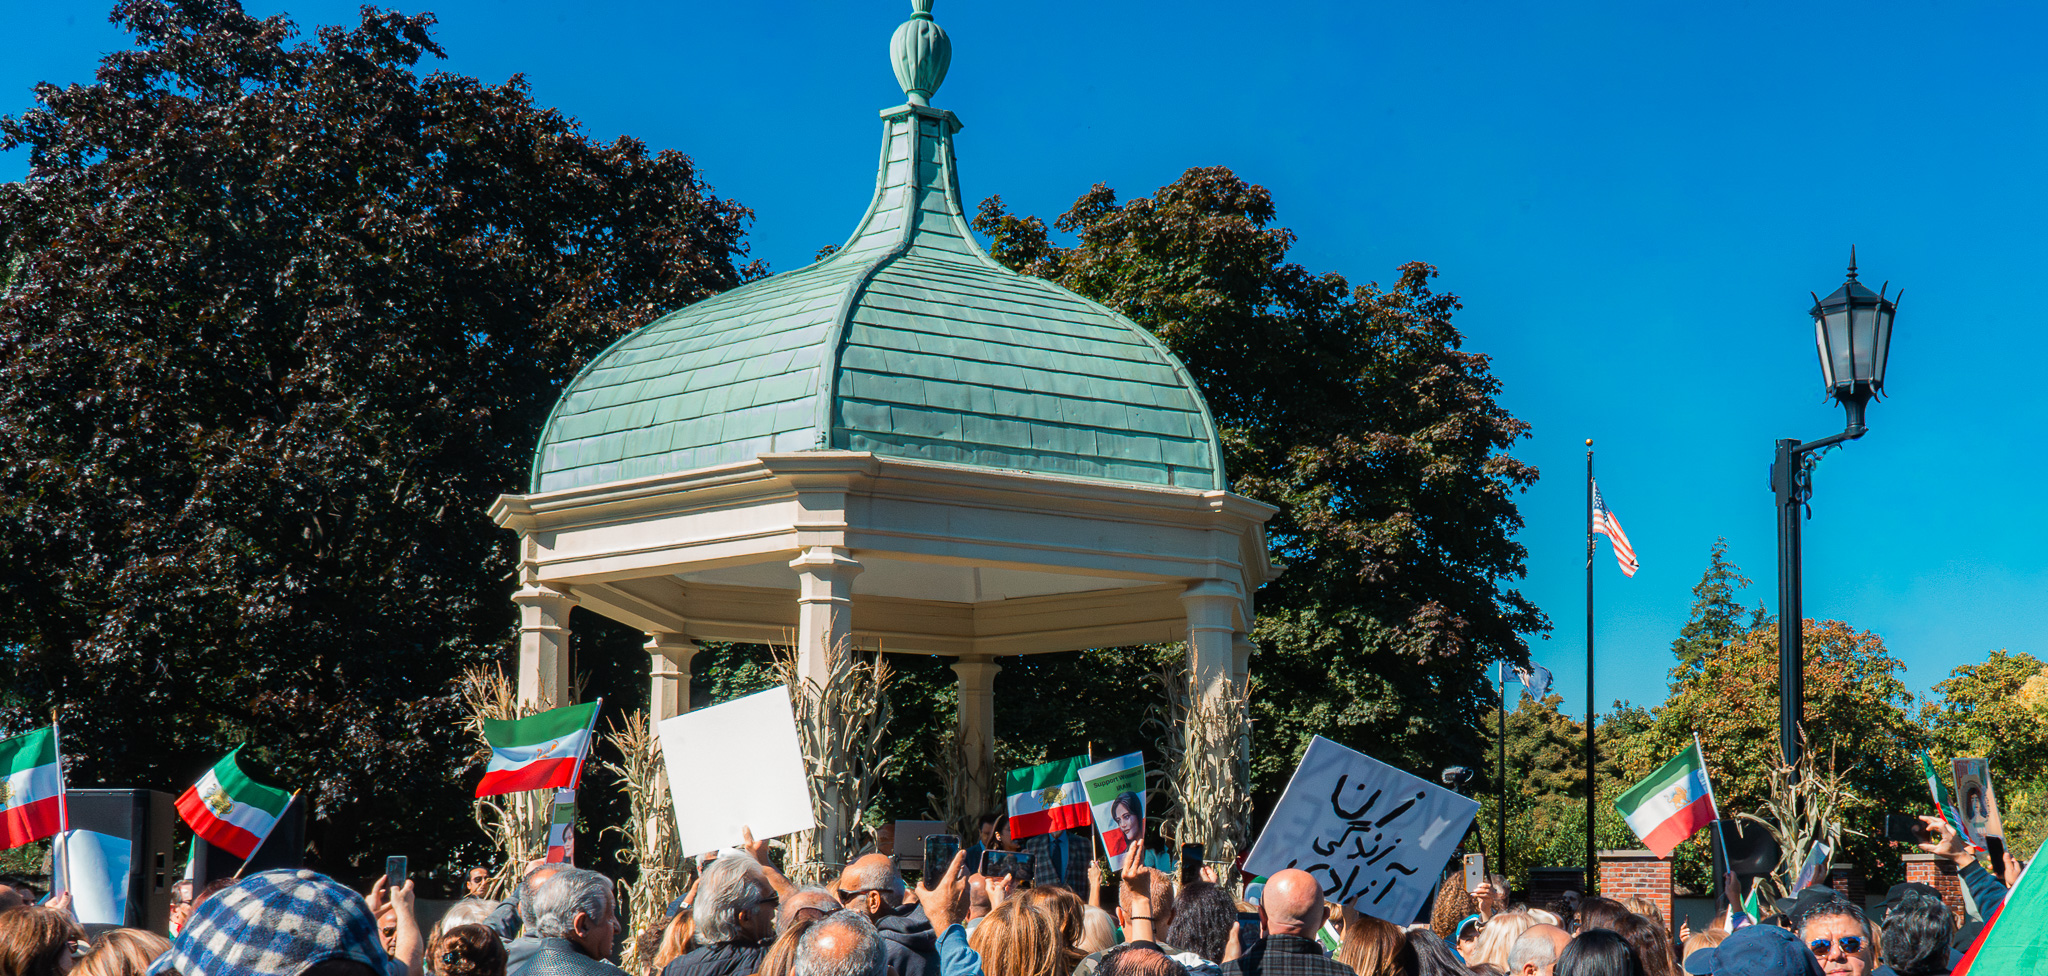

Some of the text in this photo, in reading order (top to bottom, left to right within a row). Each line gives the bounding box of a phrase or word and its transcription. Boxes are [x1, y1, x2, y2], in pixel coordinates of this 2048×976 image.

[1093, 776, 1118, 788] Support
[1116, 782, 1131, 791] IRAN
[1331, 774, 1426, 828] زن
[1312, 820, 1402, 866] زندگی
